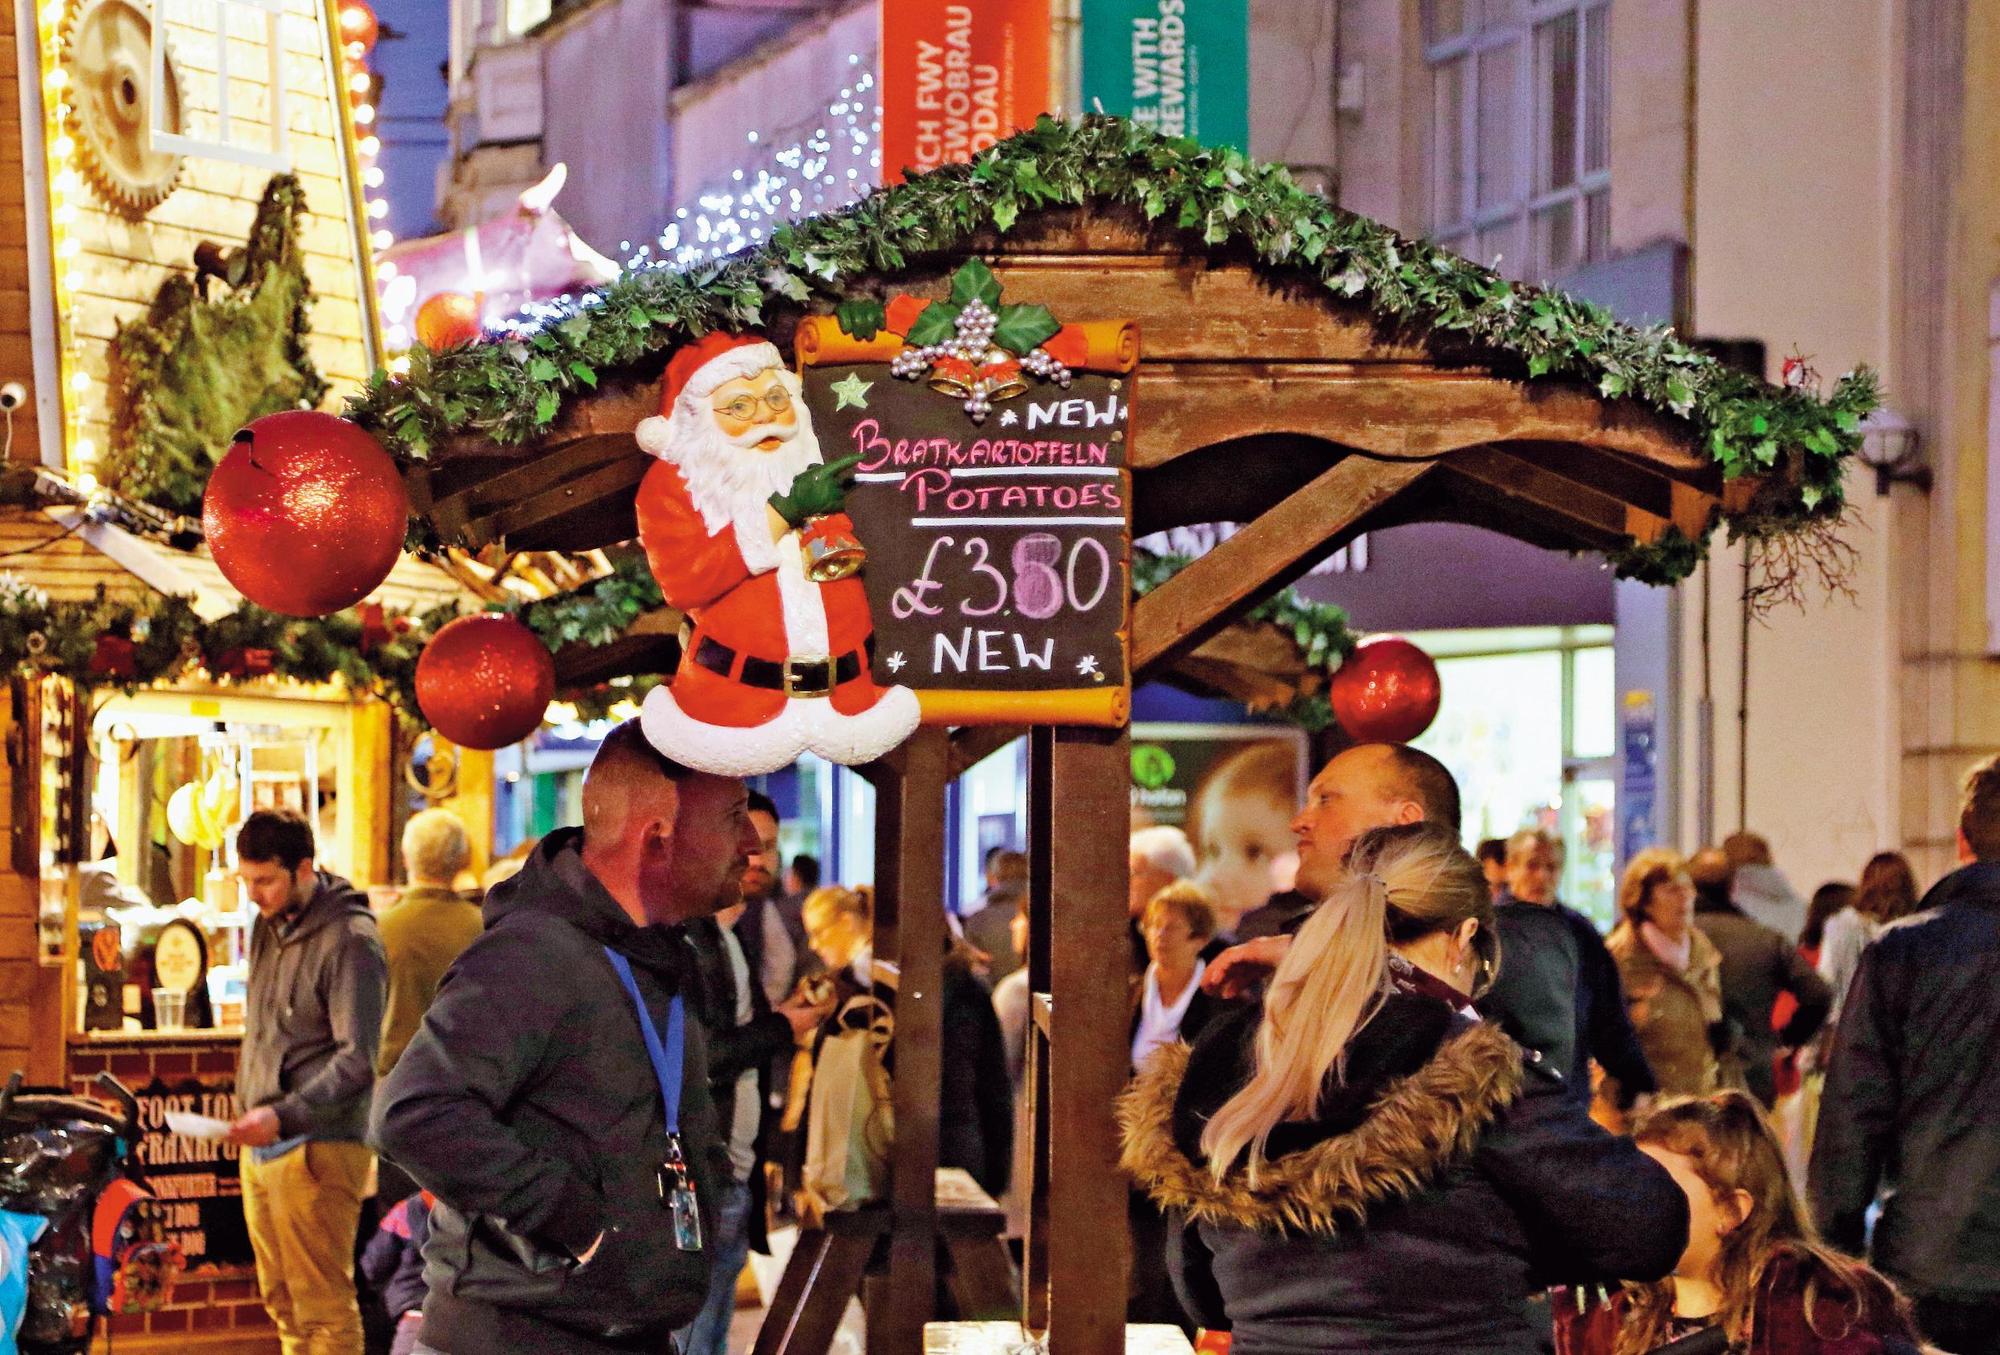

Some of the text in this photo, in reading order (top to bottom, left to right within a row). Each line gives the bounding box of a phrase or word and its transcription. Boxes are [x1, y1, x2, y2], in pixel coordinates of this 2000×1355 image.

[915, 39, 944, 110] FWY
[1132, 18, 1158, 99] WITH
[1159, 0, 1185, 138] REWARDS
[1027, 395, 1117, 430] NEW
[900, 467, 1122, 511] POTATOES
[933, 627, 1054, 674] NEW
